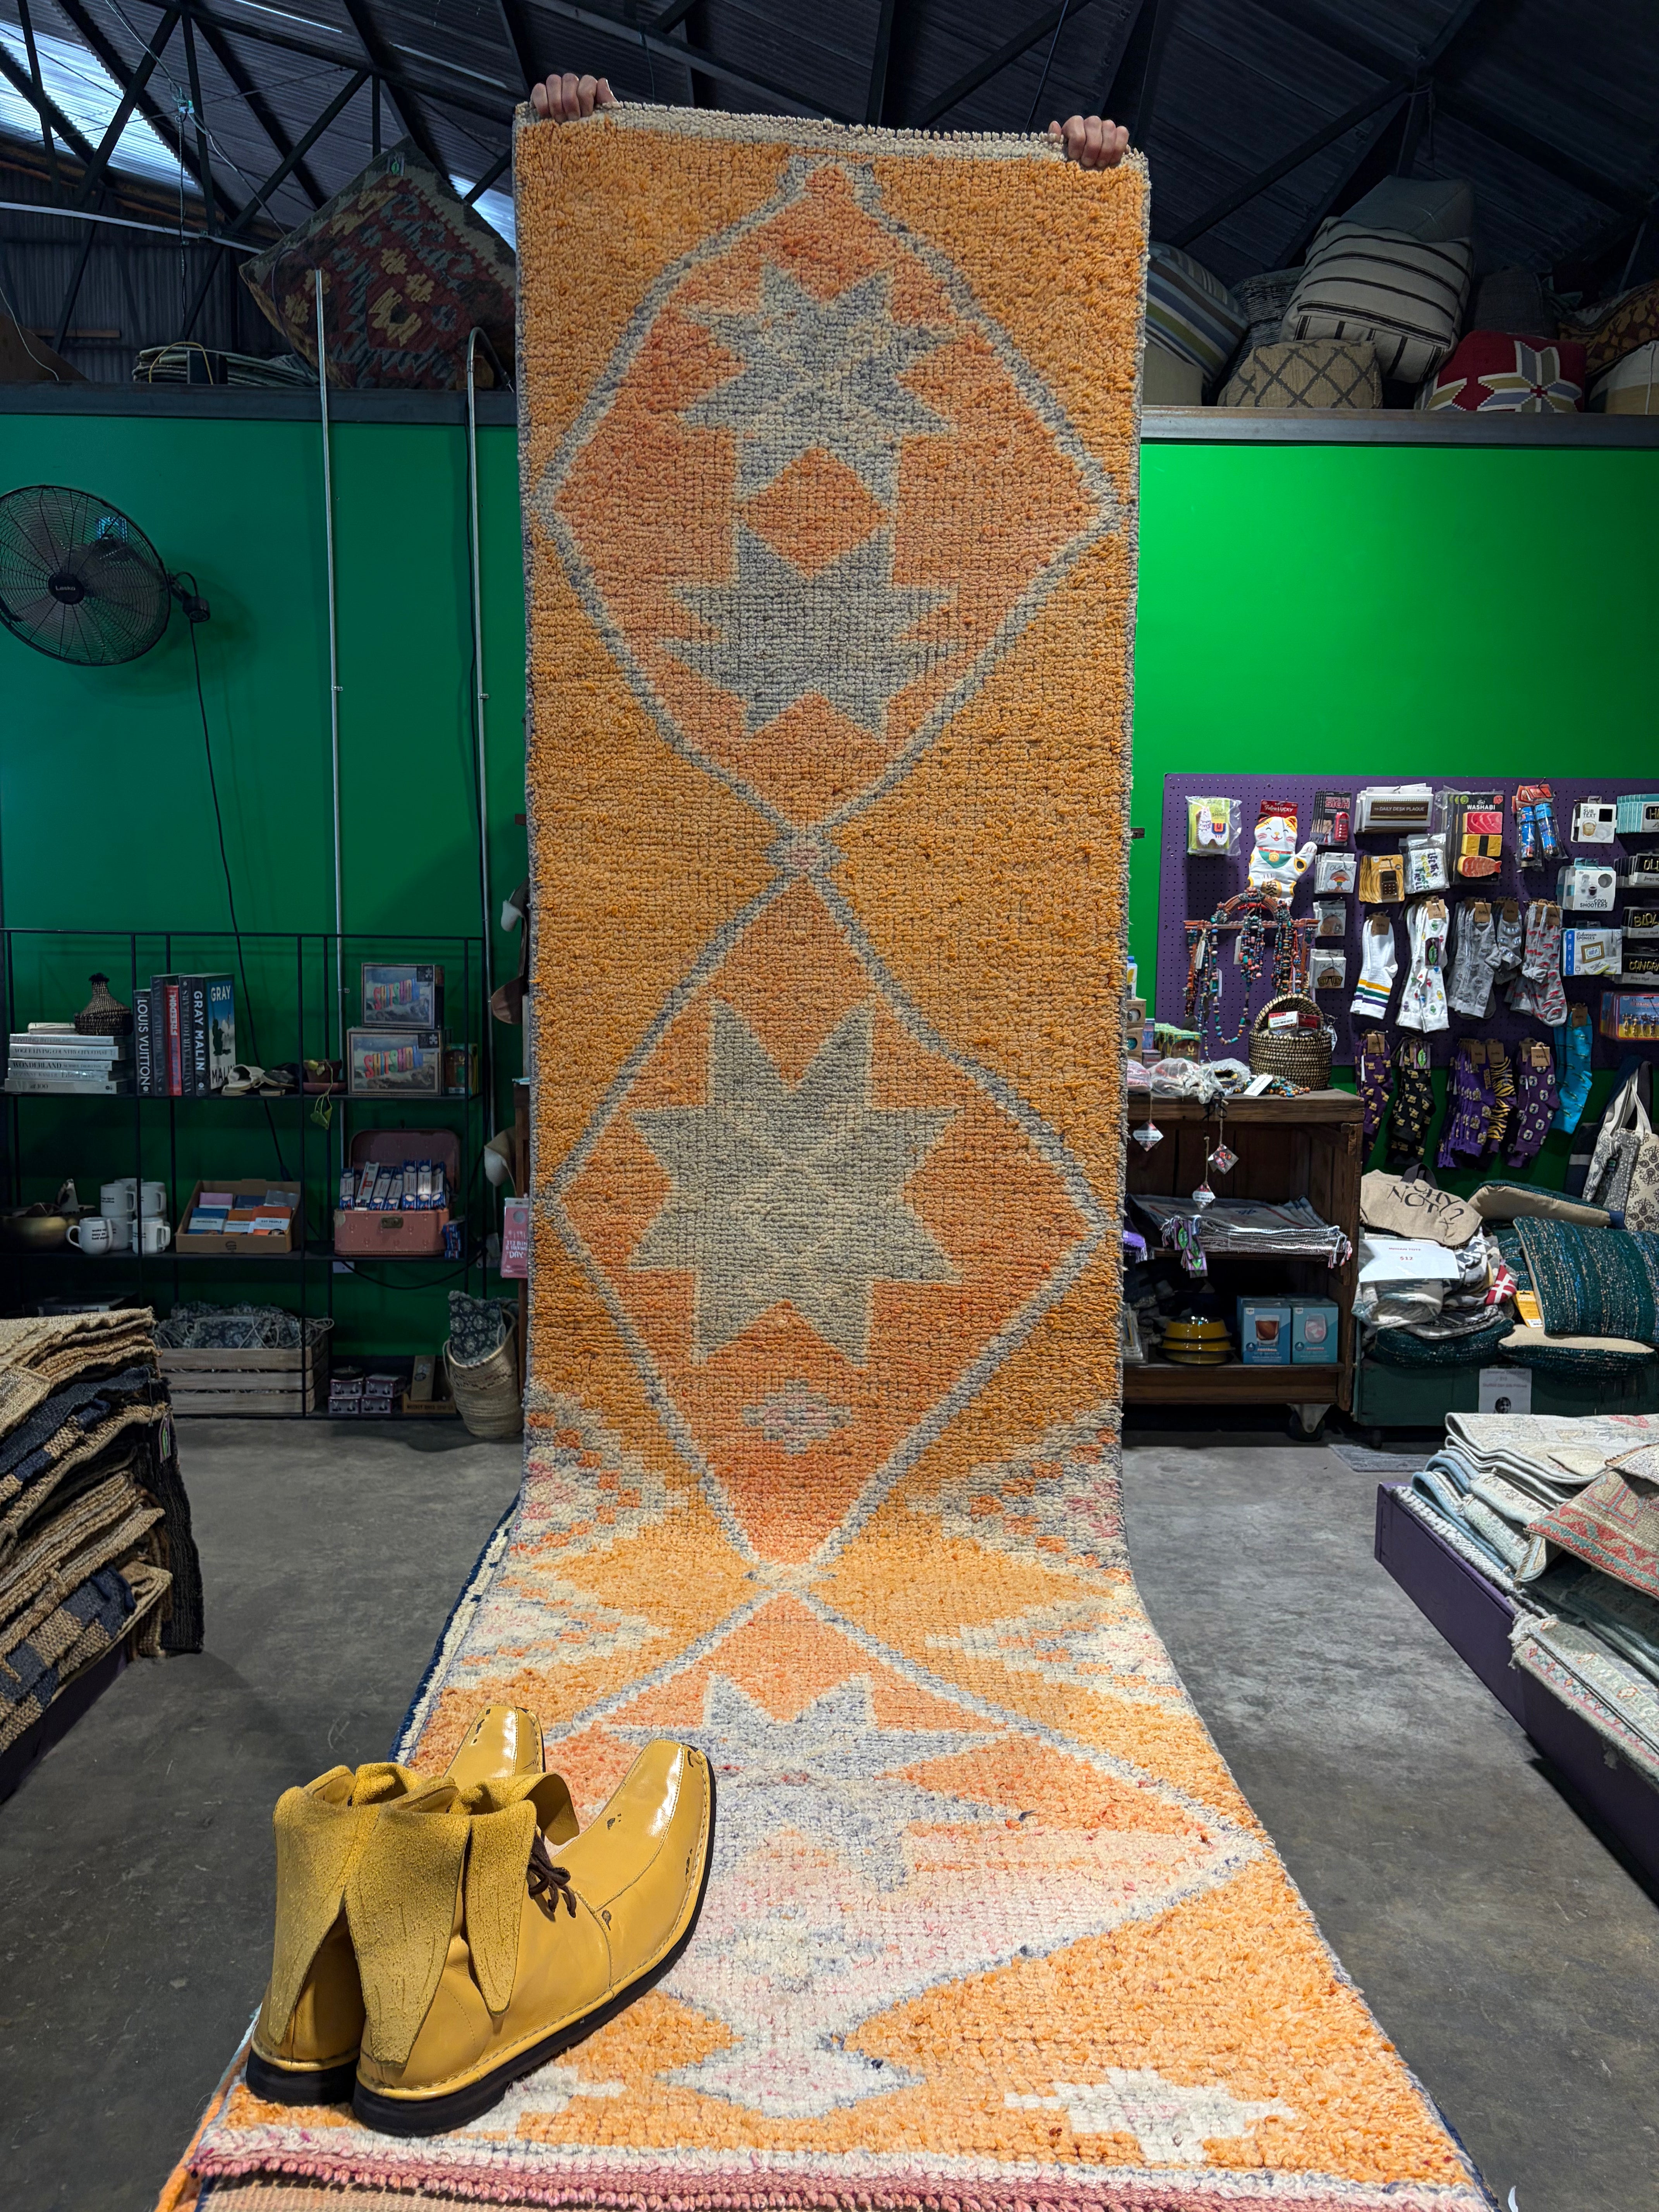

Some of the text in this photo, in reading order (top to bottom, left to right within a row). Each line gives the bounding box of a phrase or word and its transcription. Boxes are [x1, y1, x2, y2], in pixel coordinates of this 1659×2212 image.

[1325, 800, 1350, 809] SIGH
[211, 986, 231, 1002] GRAY
[137, 999, 151, 1086] LOUIS VUITTON
[194, 991, 205, 1070] GRAY MALIN
